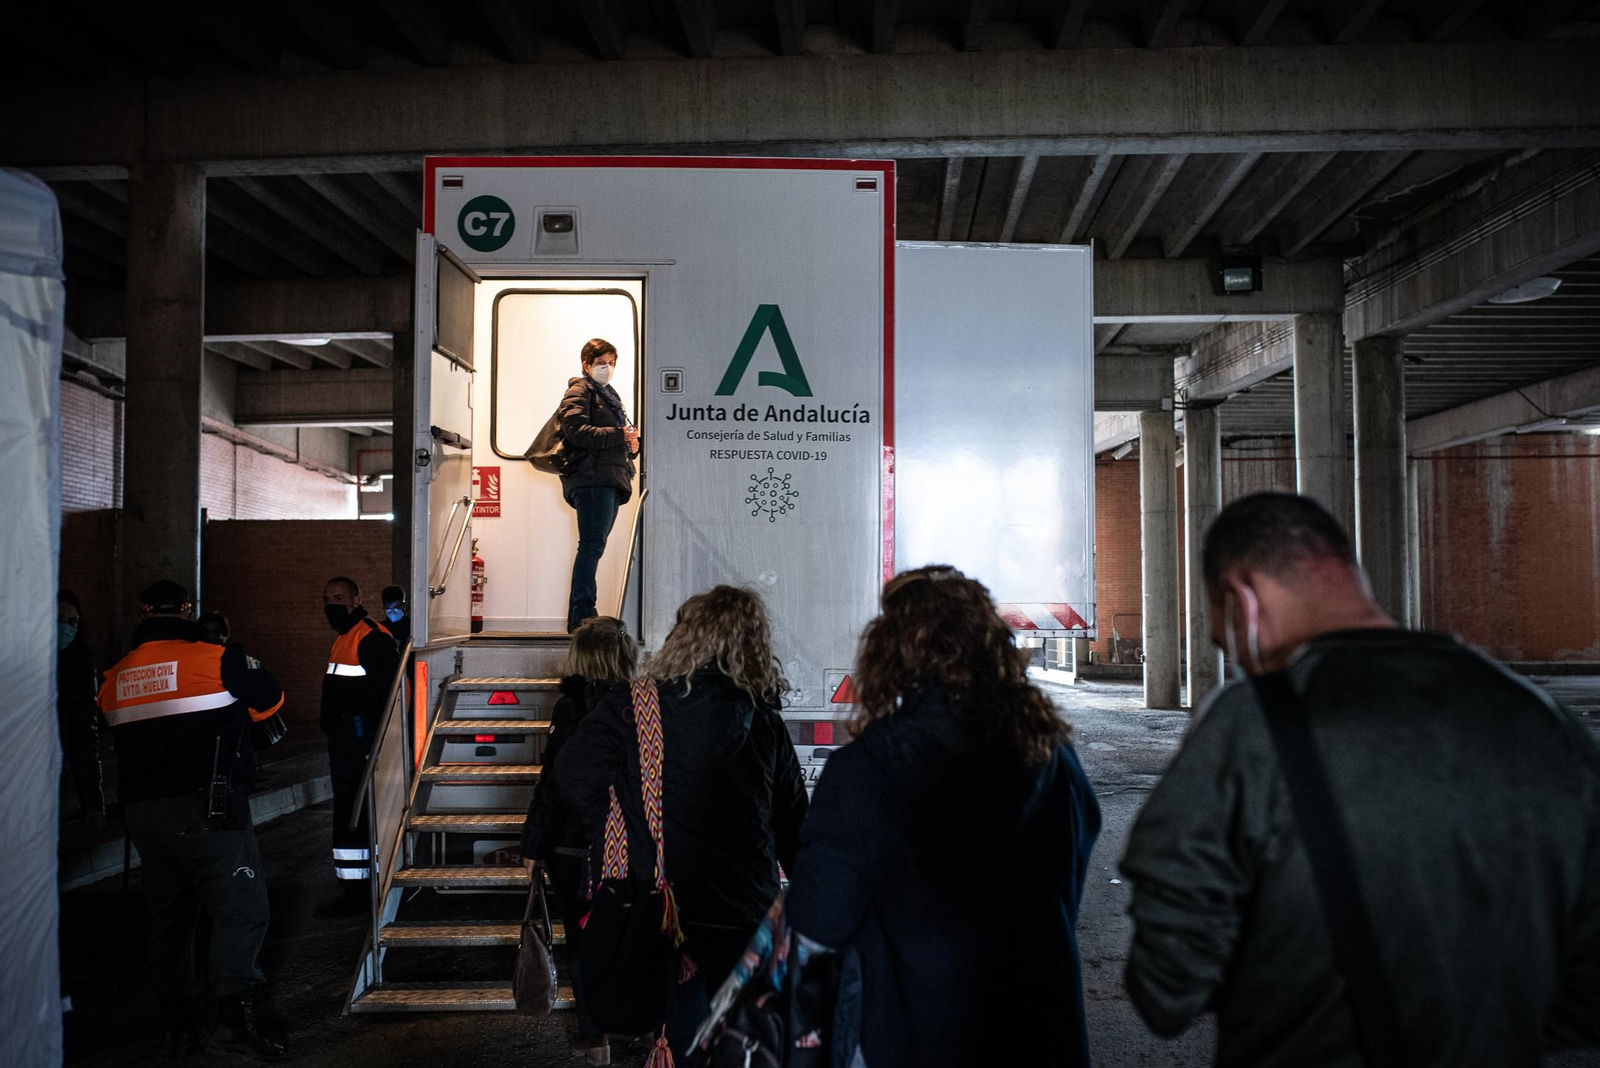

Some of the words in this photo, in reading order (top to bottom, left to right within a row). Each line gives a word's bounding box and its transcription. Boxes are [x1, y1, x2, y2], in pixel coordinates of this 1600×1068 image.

[464, 211, 510, 237] C7
[666, 403, 727, 422] Junta
[733, 403, 759, 422] de
[764, 403, 870, 424] Andalucía
[686, 429, 744, 442] Consejería
[747, 430, 761, 441] de
[763, 430, 794, 441] Salud
[796, 433, 804, 444] y
[806, 431, 851, 442] Familias
[710, 450, 774, 460] RESPUESTA
[776, 450, 827, 461] COVID-19
[472, 506, 500, 514] XTINTOR
[157, 664, 174, 677] CIVIL
[143, 679, 169, 693] HUELVA
